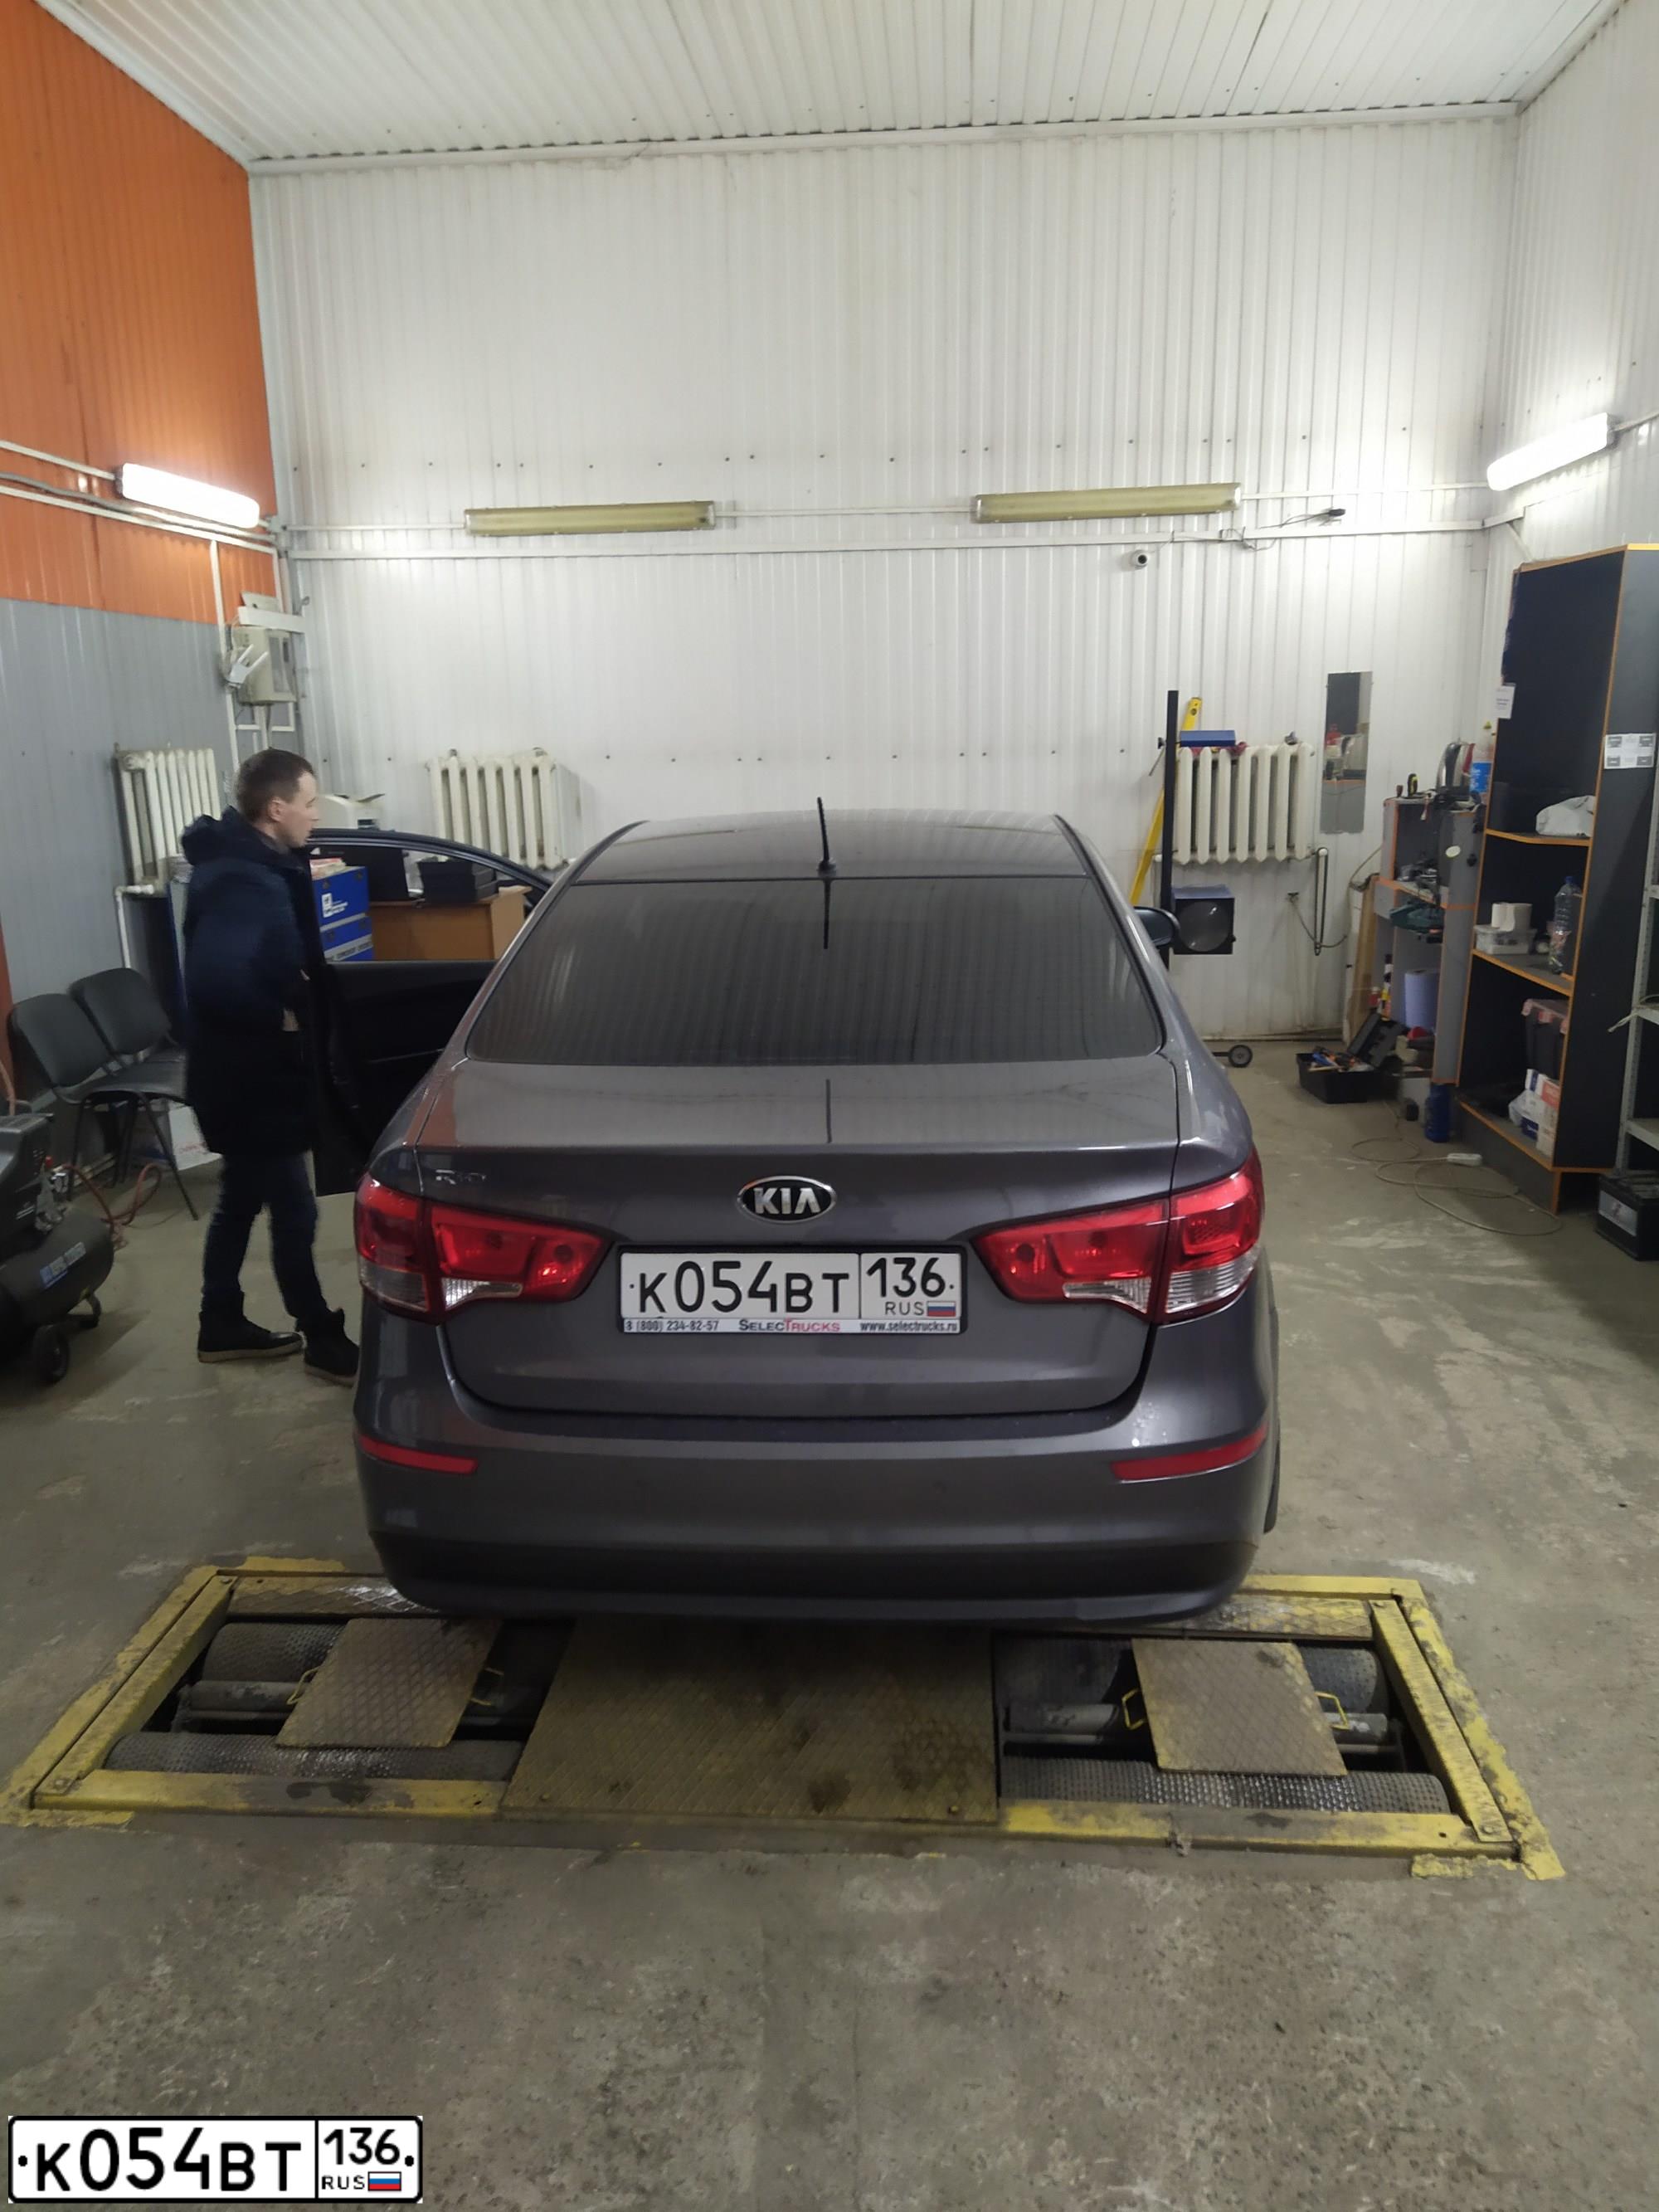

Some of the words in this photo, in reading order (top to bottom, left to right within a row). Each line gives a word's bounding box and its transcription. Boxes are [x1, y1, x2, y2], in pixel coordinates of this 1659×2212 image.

[753, 1187, 821, 1215] KIA
[639, 1260, 849, 1313] К054ВТ
[867, 1257, 946, 1298] 136
[885, 1301, 924, 1316] RUS
